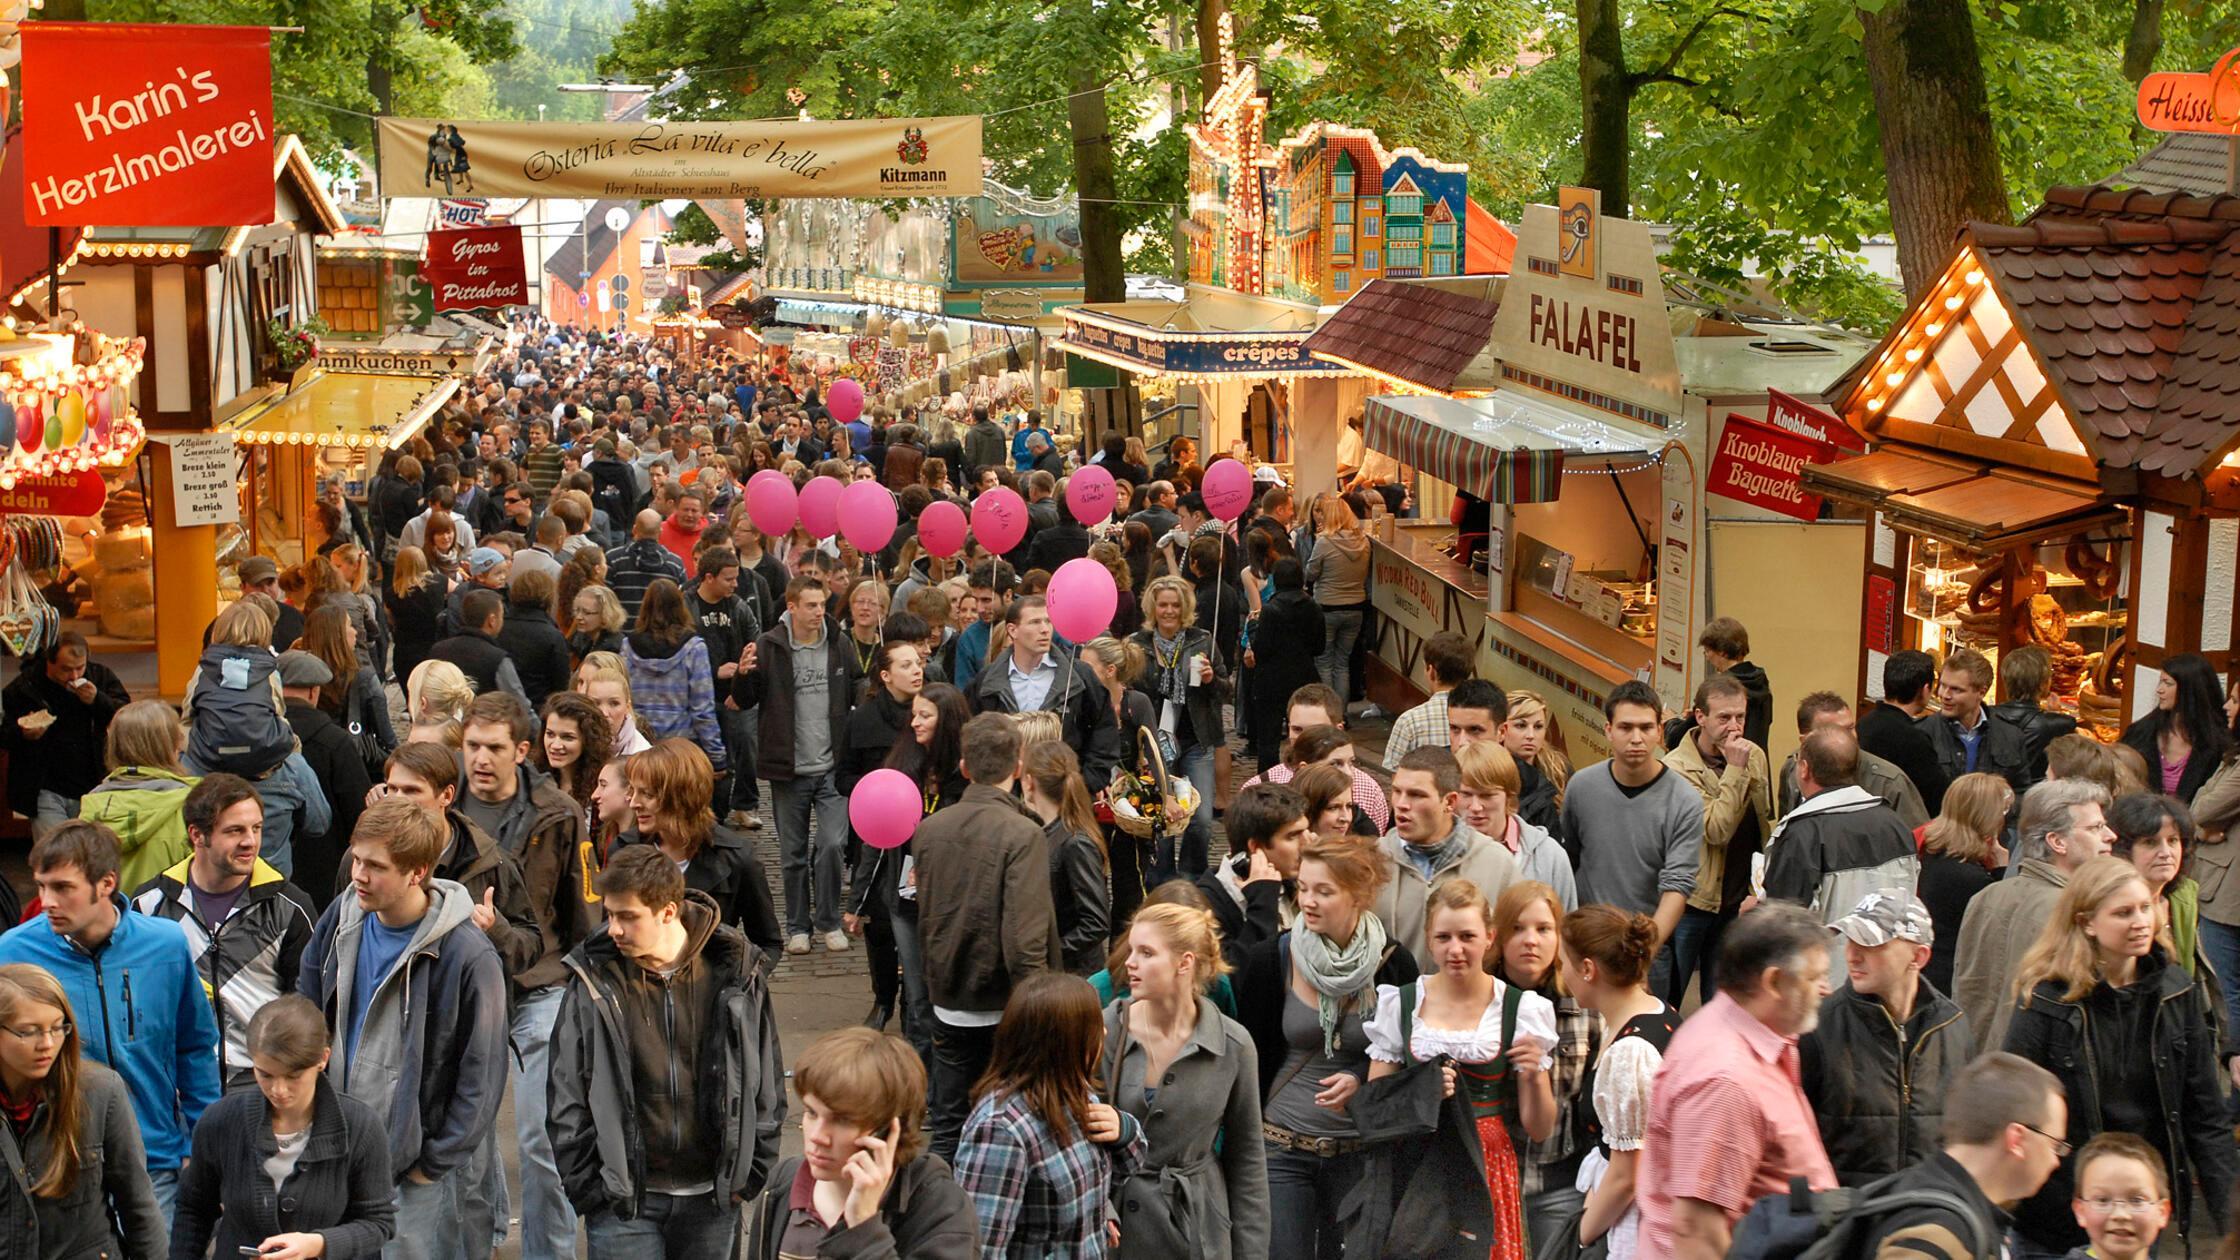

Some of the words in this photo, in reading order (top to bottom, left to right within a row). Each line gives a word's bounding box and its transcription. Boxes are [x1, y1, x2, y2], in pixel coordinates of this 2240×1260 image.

[74, 66, 219, 142] Karin's
[30, 109, 266, 216] Herzlmalerei
[523, 137, 616, 182] Osteria
[880, 167, 947, 183] Kitzmann
[604, 181, 625, 195] Ihr
[634, 181, 695, 195] Italiener
[701, 186, 722, 195] am
[730, 182, 761, 197] Berg
[446, 207, 481, 223] HOT
[452, 238, 501, 262] Gyros
[467, 263, 489, 276] im
[442, 280, 519, 303] Pittabrot
[1530, 293, 1641, 374] FALAFEL
[1223, 343, 1299, 365] crêpes
[206, 461, 226, 470] klein
[192, 502, 223, 512] Rettich
[1376, 561, 1403, 588] WODKA
[1404, 567, 1419, 597] RED
[1420, 580, 1439, 625] BULL
